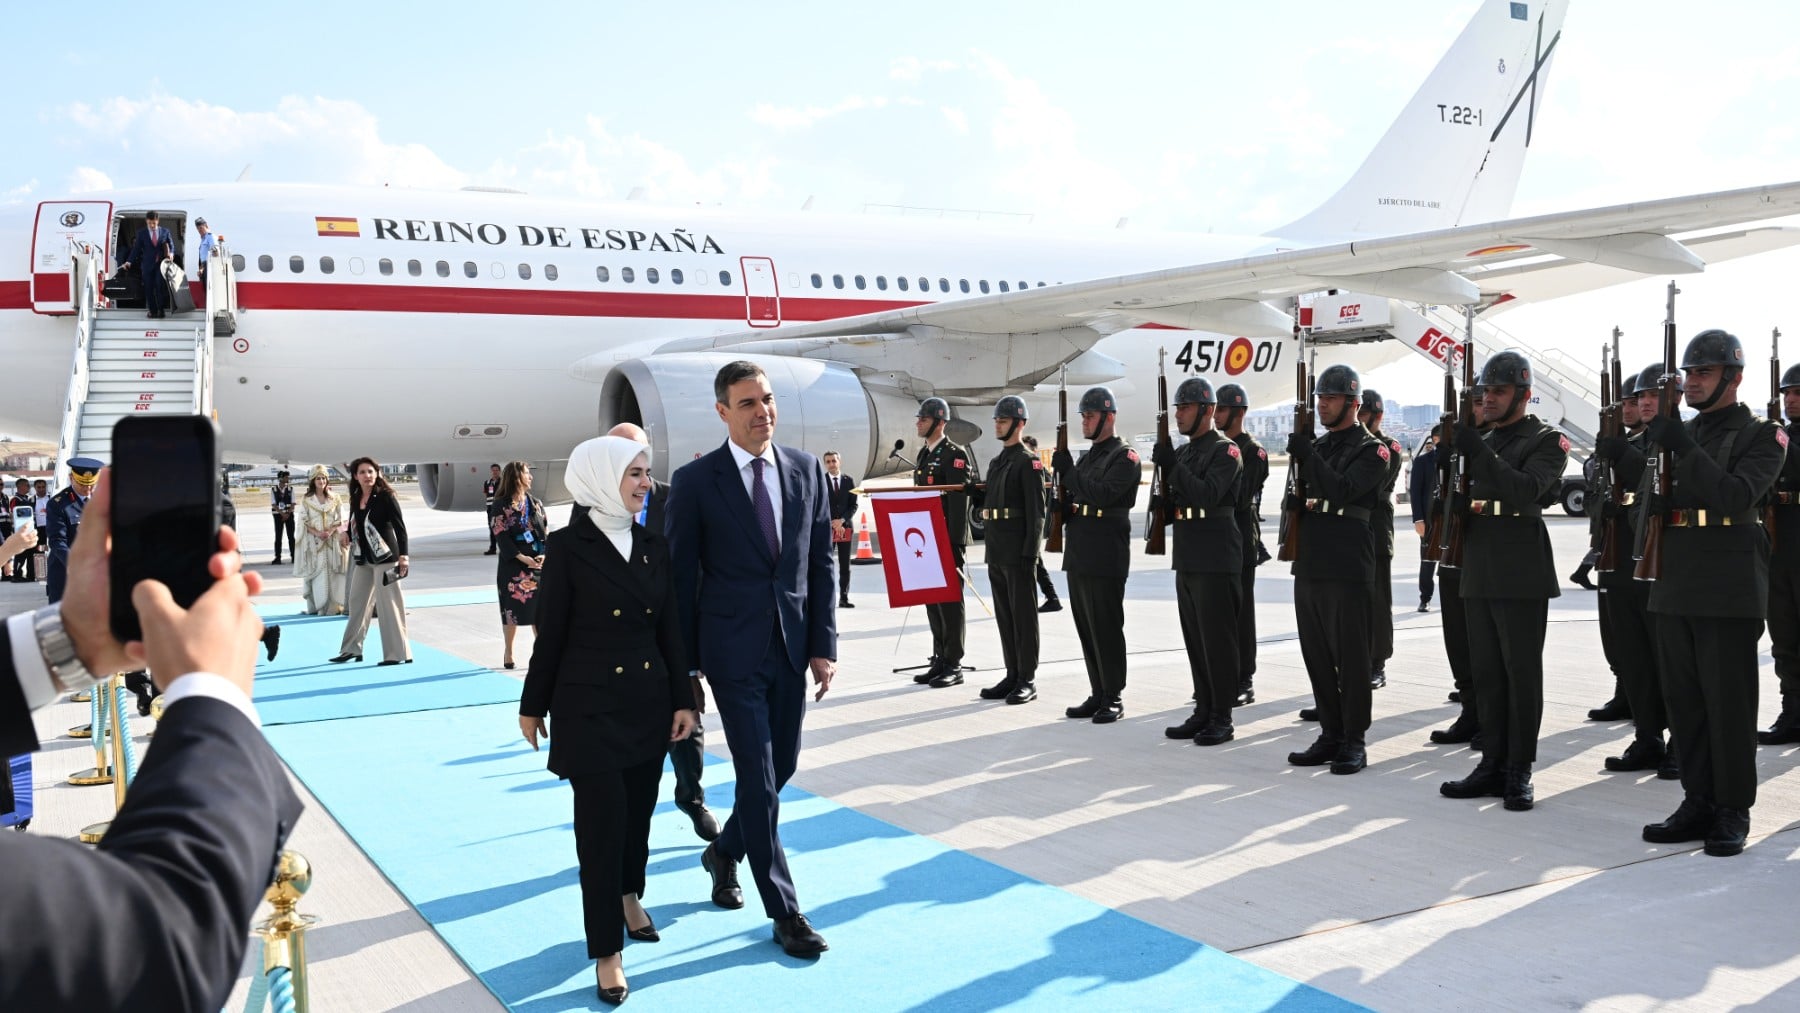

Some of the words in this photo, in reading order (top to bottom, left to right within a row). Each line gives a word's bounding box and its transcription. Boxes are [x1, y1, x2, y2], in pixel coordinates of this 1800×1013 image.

[1436, 103, 1483, 127] T.22-1
[371, 217, 507, 246] REINO
[516, 224, 572, 248] DE
[579, 227, 726, 255] ESPAÑA
[1175, 340, 1224, 373] 451
[1253, 341, 1283, 373] 01
